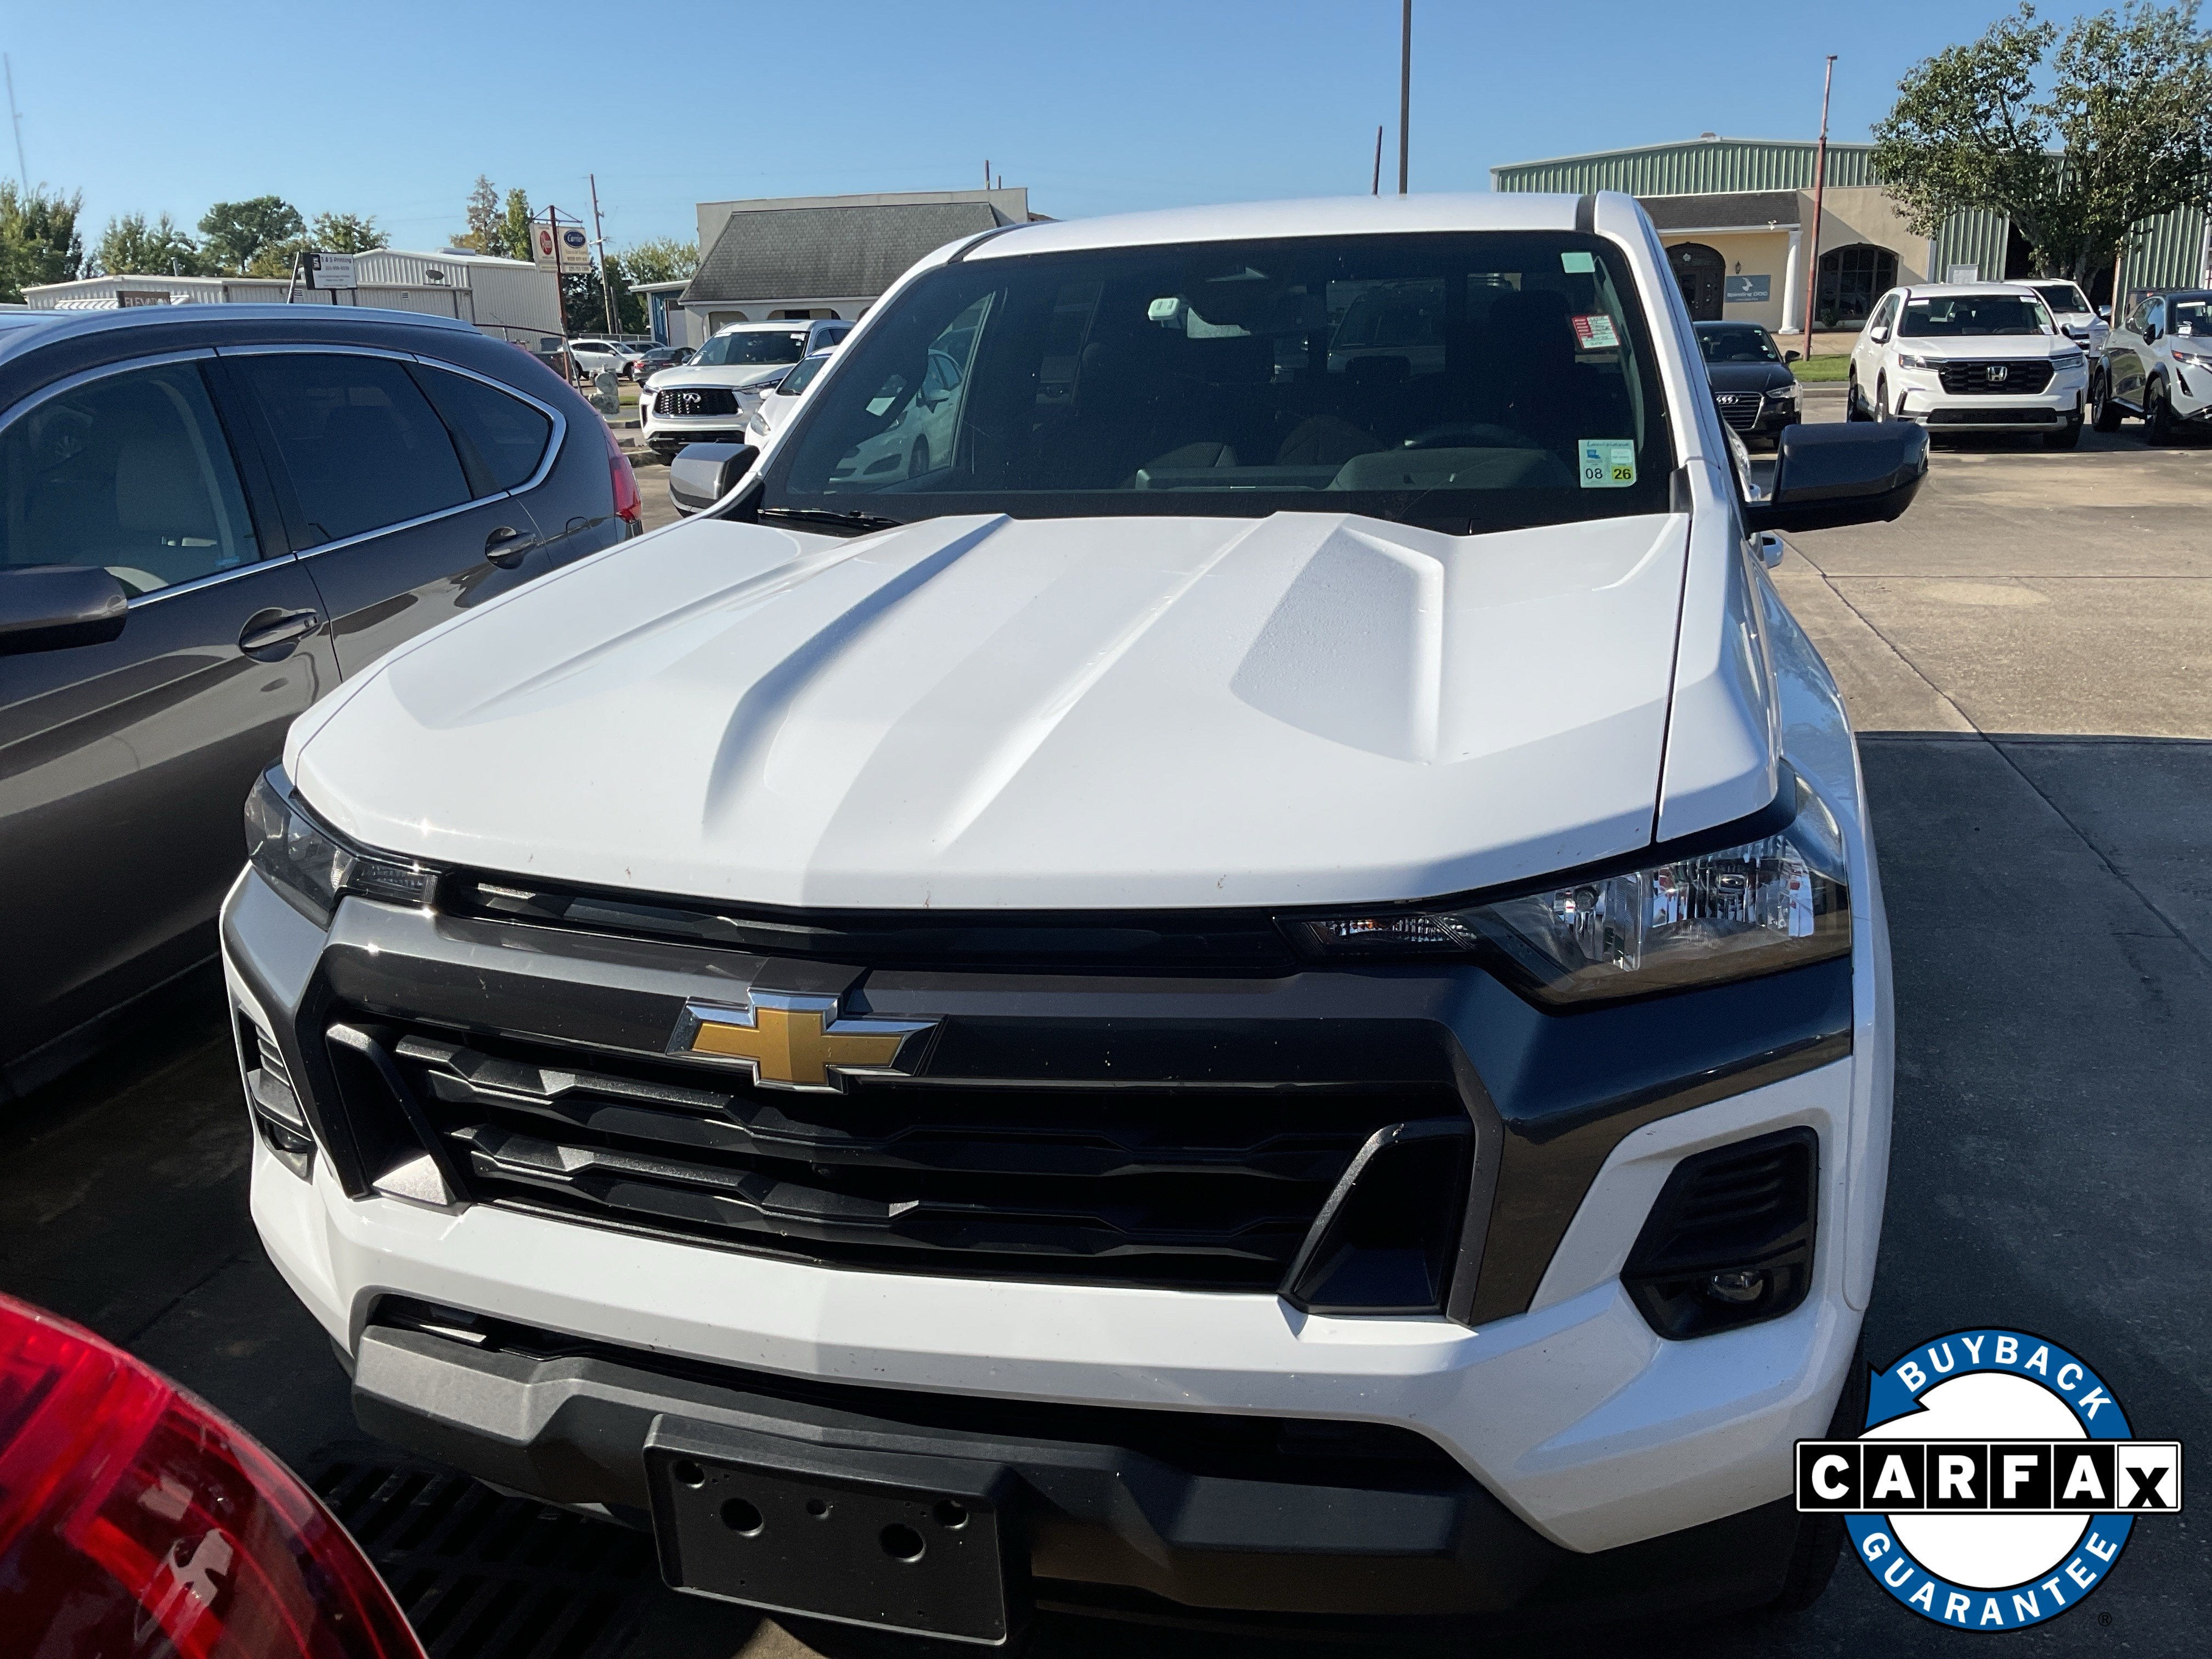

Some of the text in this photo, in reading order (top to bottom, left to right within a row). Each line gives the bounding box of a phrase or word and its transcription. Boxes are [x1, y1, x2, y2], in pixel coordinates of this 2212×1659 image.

[567, 234, 583, 242] Carrier
[1585, 468, 1631, 479] 08 26
